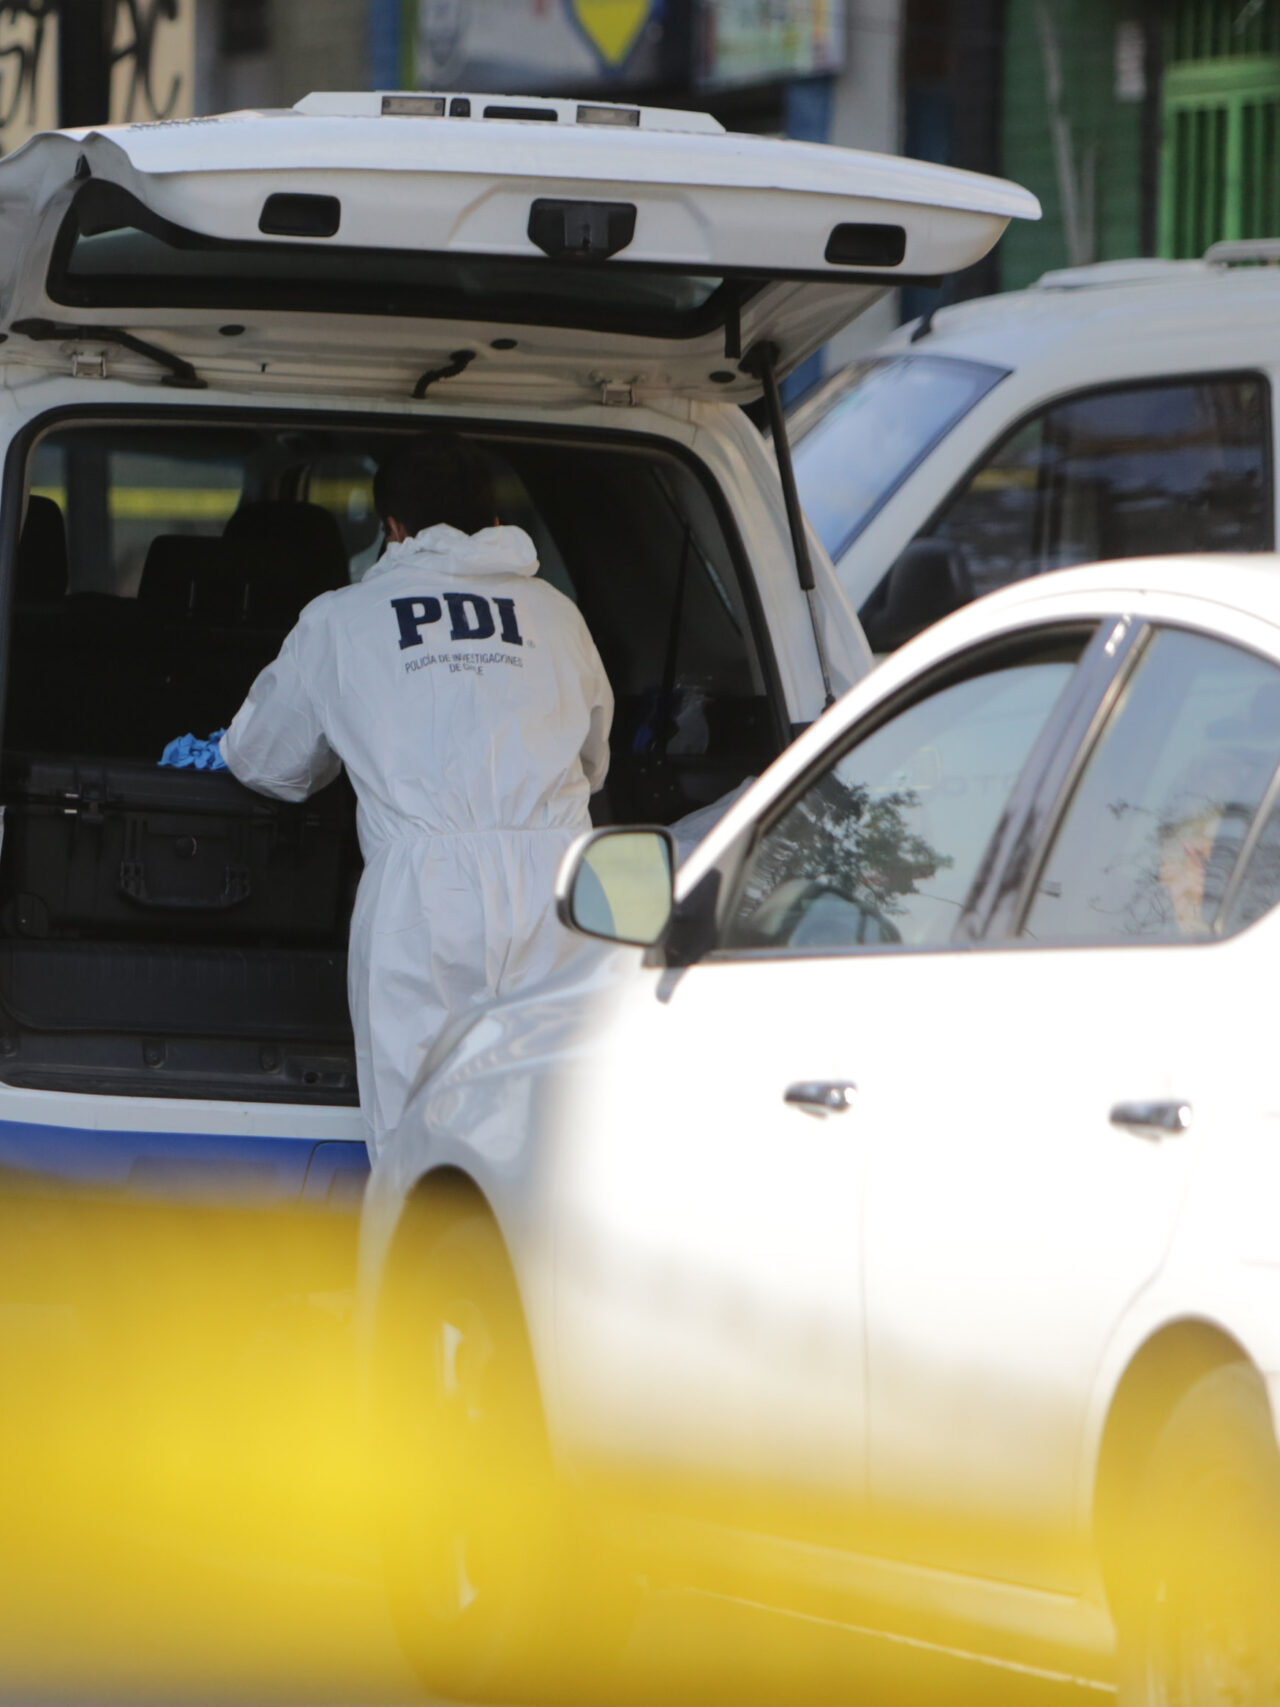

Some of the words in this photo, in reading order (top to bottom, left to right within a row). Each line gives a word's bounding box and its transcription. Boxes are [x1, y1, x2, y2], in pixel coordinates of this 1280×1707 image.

[391, 593, 523, 650] PDI
[438, 653, 451, 664] DE
[449, 663, 461, 673] DE
